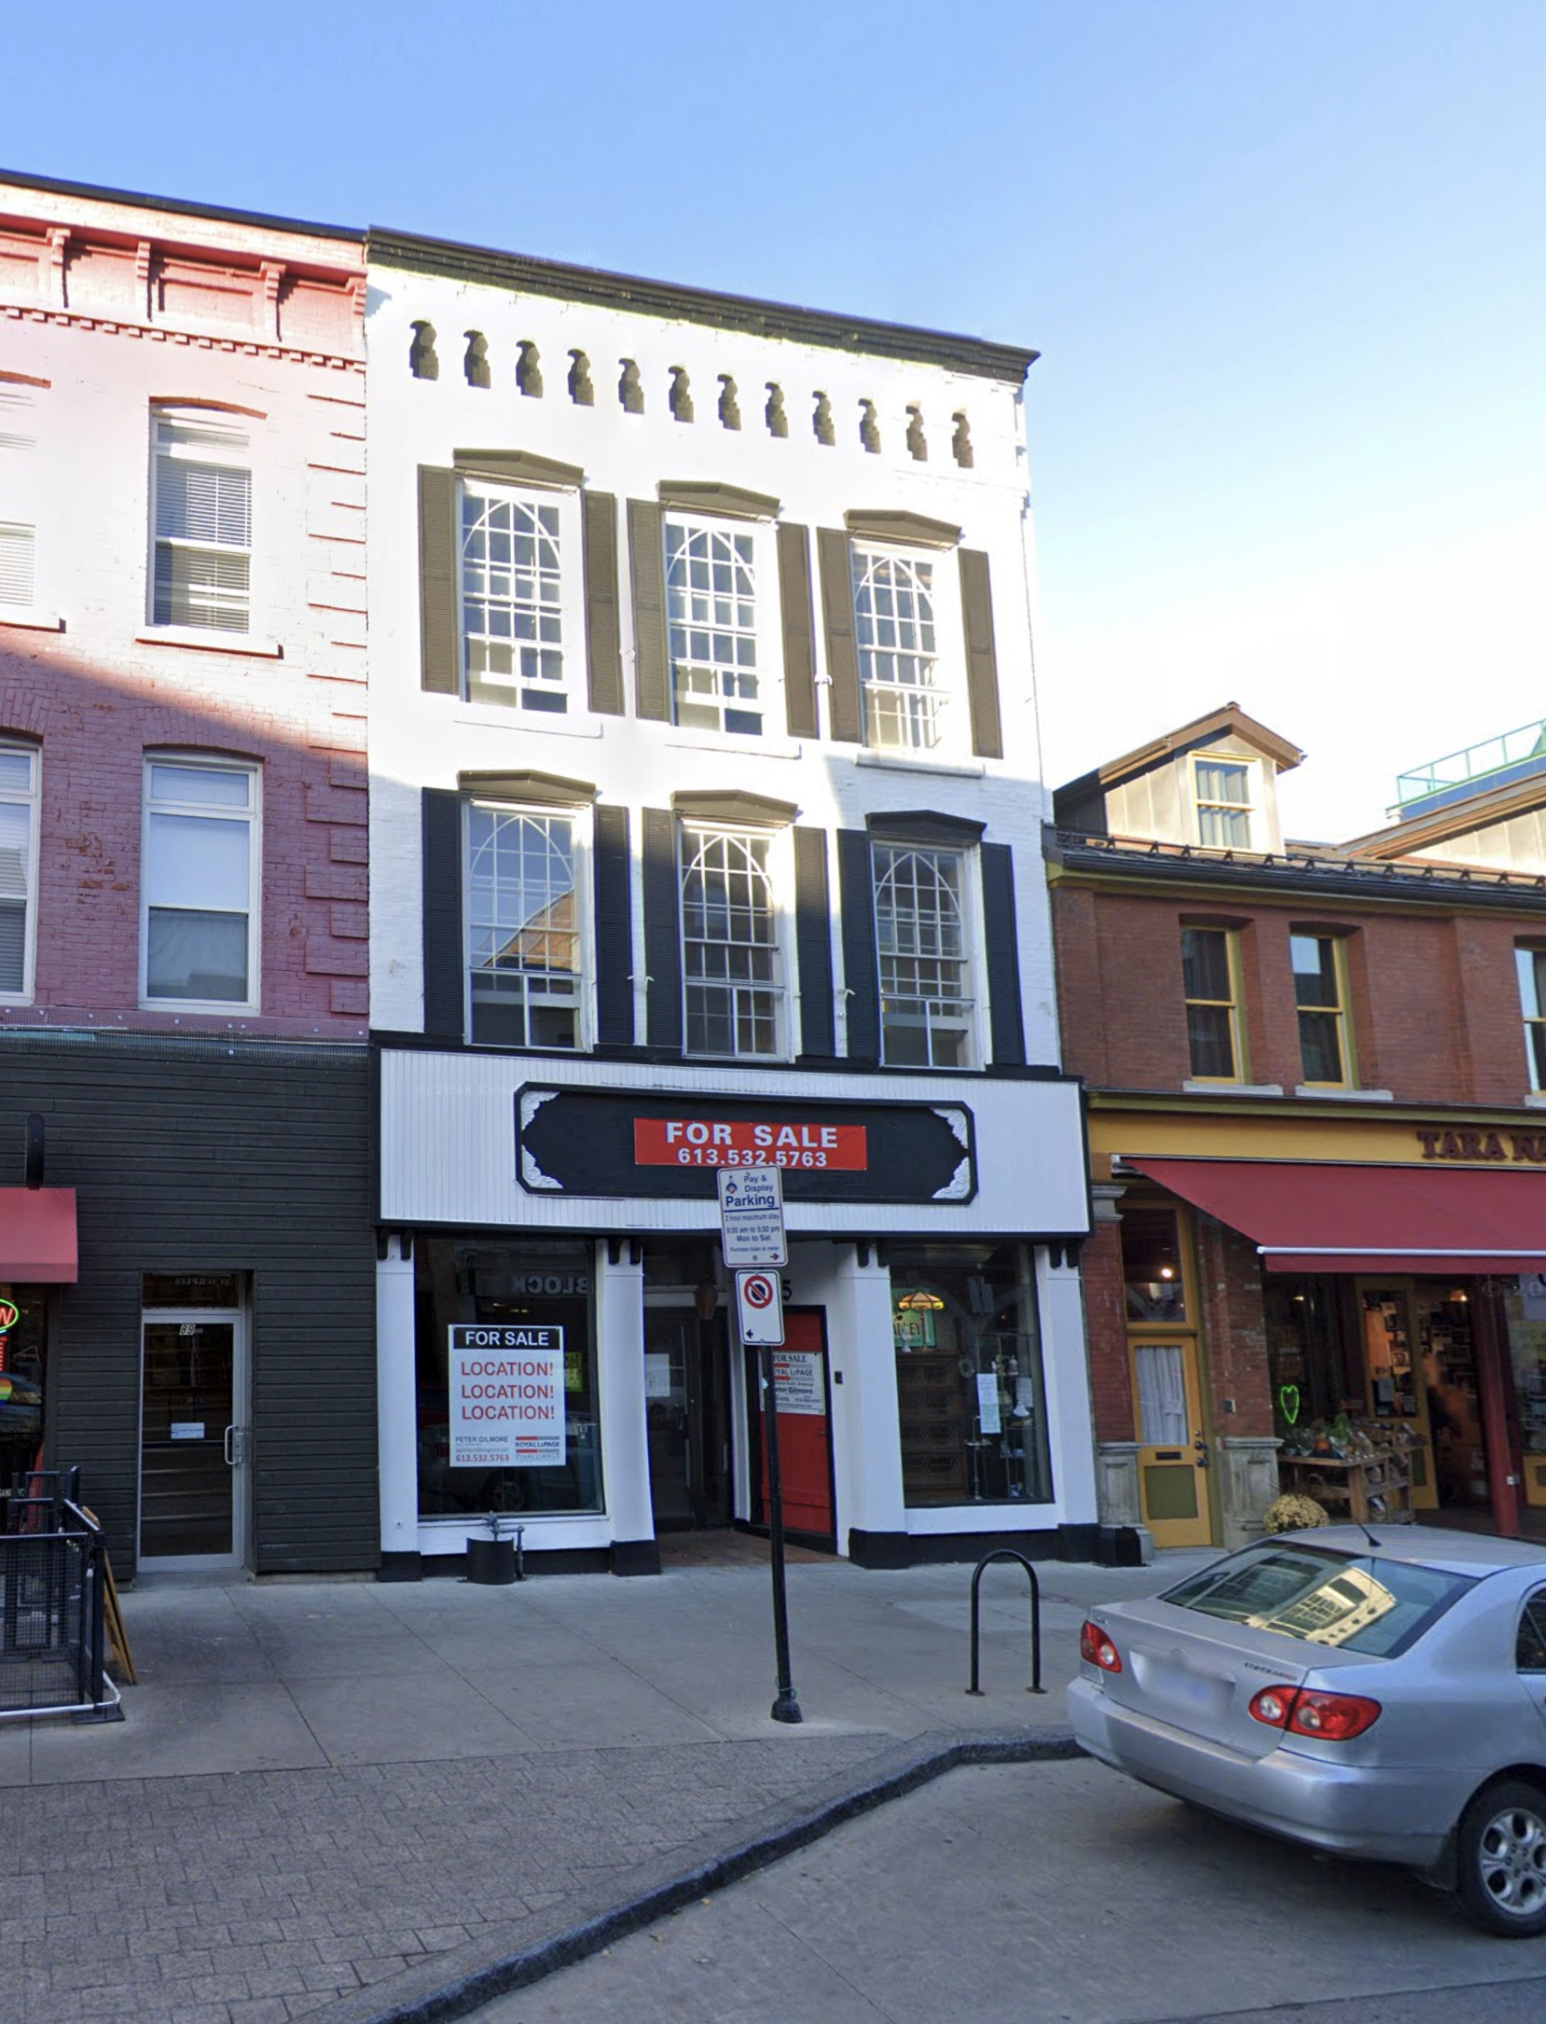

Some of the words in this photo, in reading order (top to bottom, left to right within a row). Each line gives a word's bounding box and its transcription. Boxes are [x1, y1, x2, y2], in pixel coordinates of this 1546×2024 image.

[666, 1122, 732, 1145] FOR
[754, 1125, 838, 1148] SALE
[1416, 1131, 1508, 1160] TARA
[678, 1147, 827, 1167] 613.532.5763
[744, 1175, 758, 1183] Pay
[745, 1184, 773, 1193] Display
[726, 1194, 775, 1208] Parking
[736, 1234, 750, 1242] Mon
[180, 1324, 195, 1336] 89
[466, 1331, 500, 1345] FOR
[505, 1331, 549, 1346] SALE
[788, 1355, 807, 1363] SALE
[461, 1361, 554, 1376] LOCATION!
[461, 1384, 555, 1399] LOCATION!
[462, 1405, 555, 1420] LOCATION!
[456, 1454, 509, 1463] 613.532.5763
